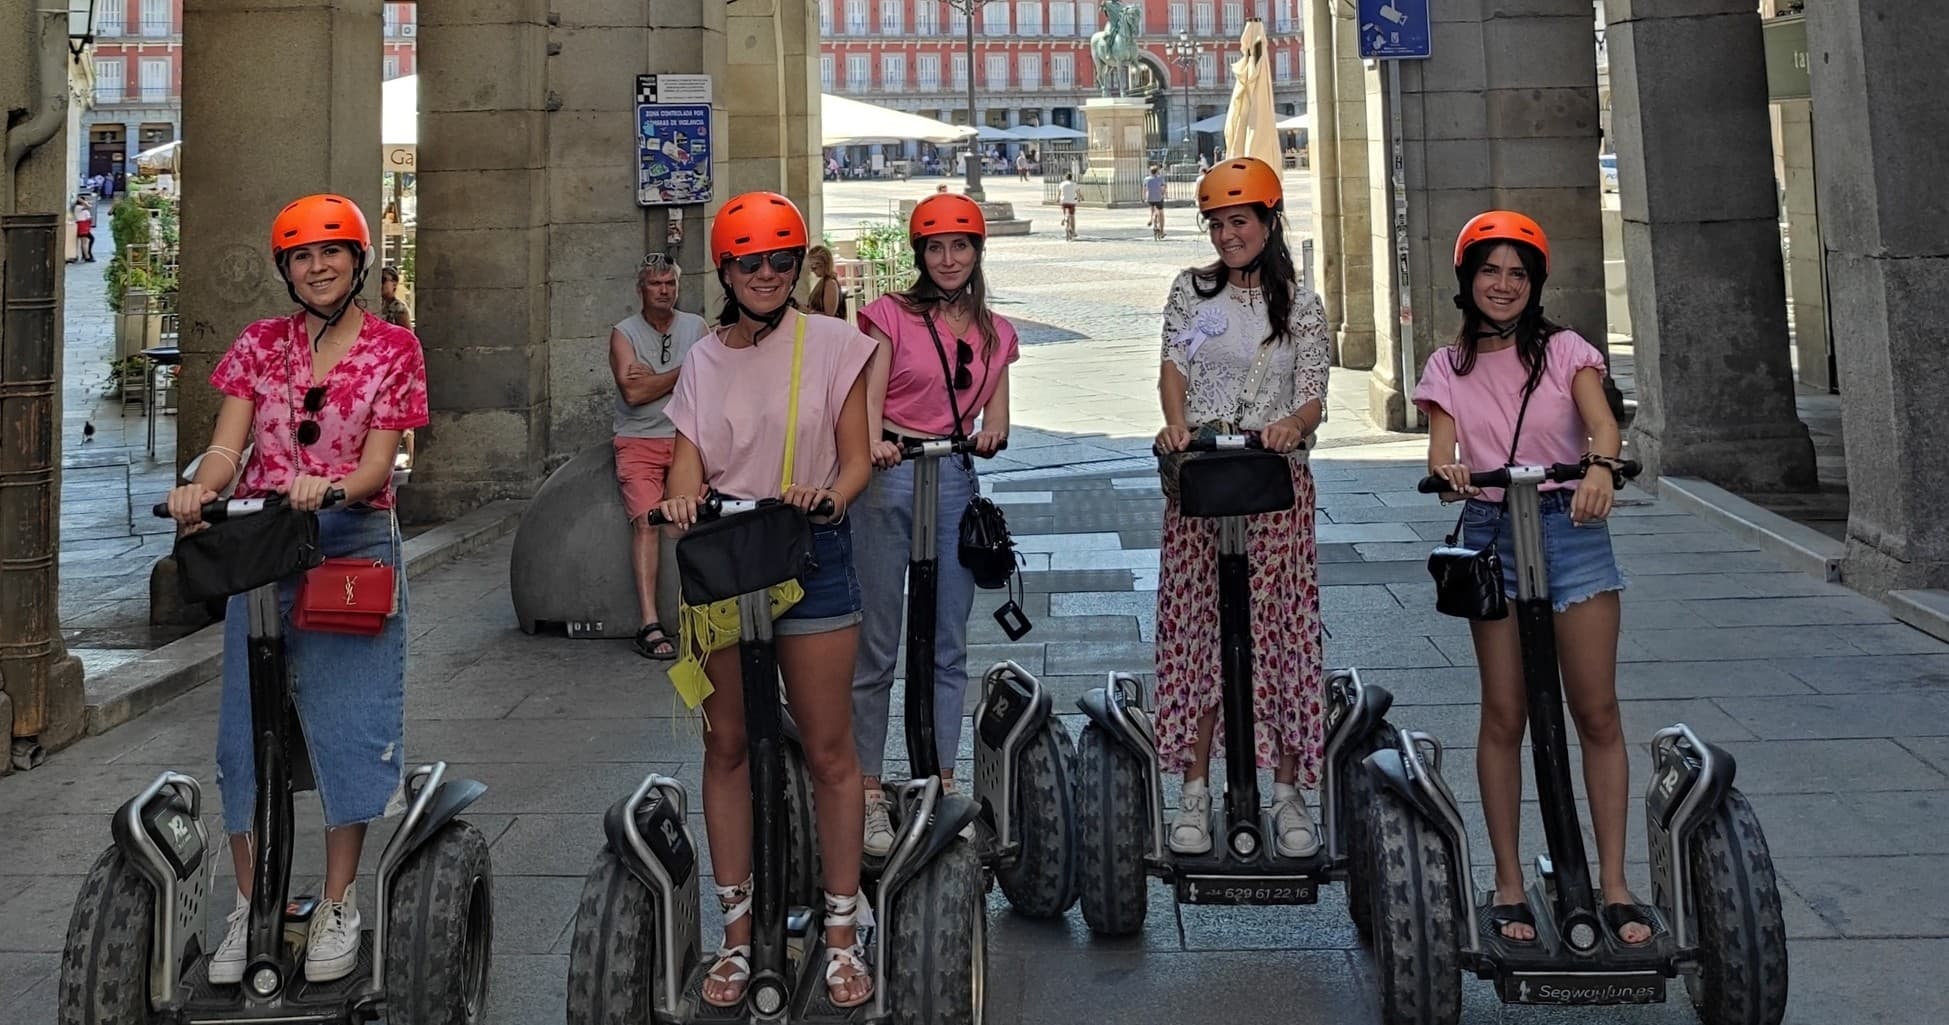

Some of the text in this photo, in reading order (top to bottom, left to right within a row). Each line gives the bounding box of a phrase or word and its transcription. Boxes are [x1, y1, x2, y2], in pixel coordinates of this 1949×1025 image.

[1794, 50, 1810, 74] ta
[1225, 888, 1252, 898] 629
[1255, 888, 1270, 899] 61
[1273, 888, 1291, 899] 22
[1295, 887, 1310, 898] 16
